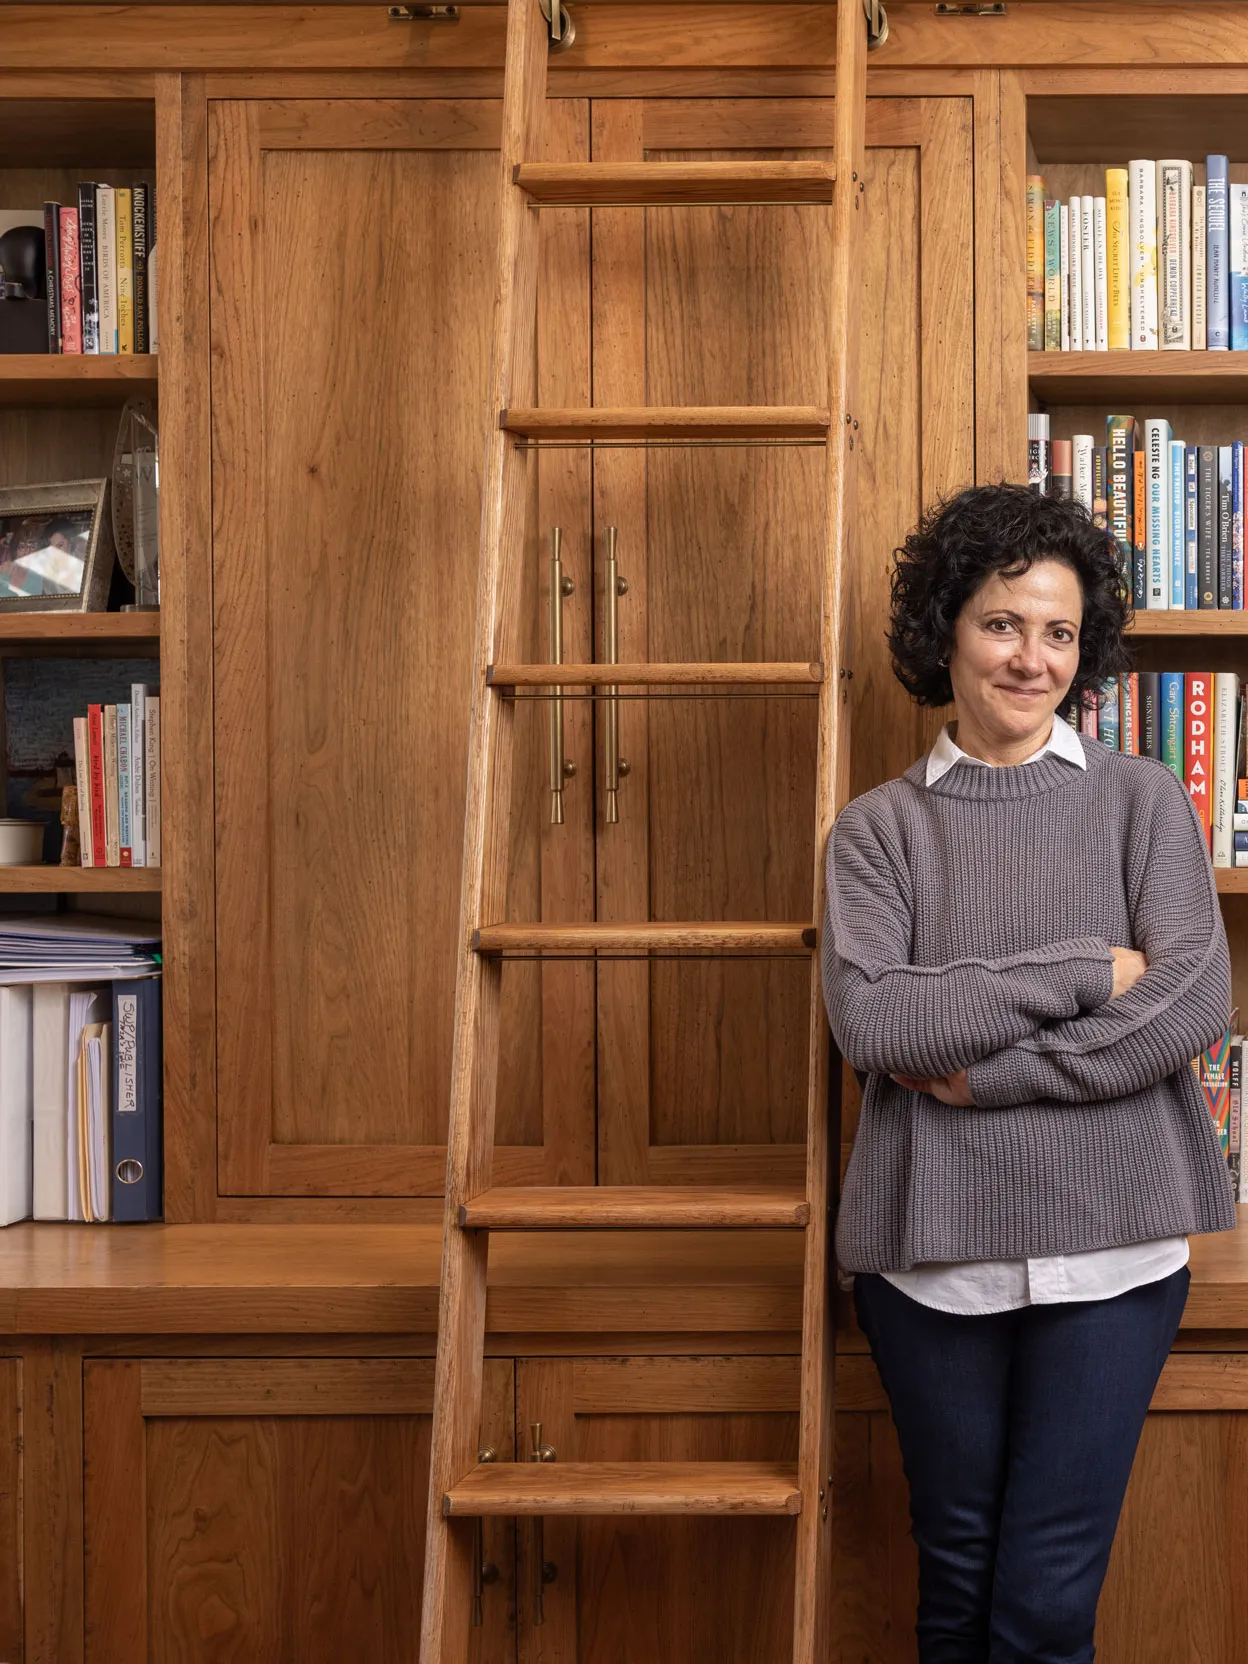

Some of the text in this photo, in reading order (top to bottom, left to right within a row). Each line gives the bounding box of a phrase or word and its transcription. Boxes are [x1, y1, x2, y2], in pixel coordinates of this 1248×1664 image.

[133, 188, 145, 258] KNOCKEMSTIFF
[1047, 213, 1056, 246] NEWS
[1208, 177, 1225, 232] THE SEQUEL
[1112, 428, 1126, 469] HELLO
[1151, 428, 1160, 583] CELESTE NG OUR MISSING HEARTS
[1222, 493, 1232, 542] Tim O'Brien
[119, 716, 127, 772] MICHAEL CHABON
[1145, 696, 1154, 749] SIGNAL FIRES
[1168, 681, 1180, 759] Gary Shteyngart
[1190, 680, 1207, 795] RODHAM
[148, 709, 157, 797] Stephen King On Writing
[123, 1001, 136, 1108] SWP/PUBLISHER
[1203, 1072, 1224, 1080] FEMALE
